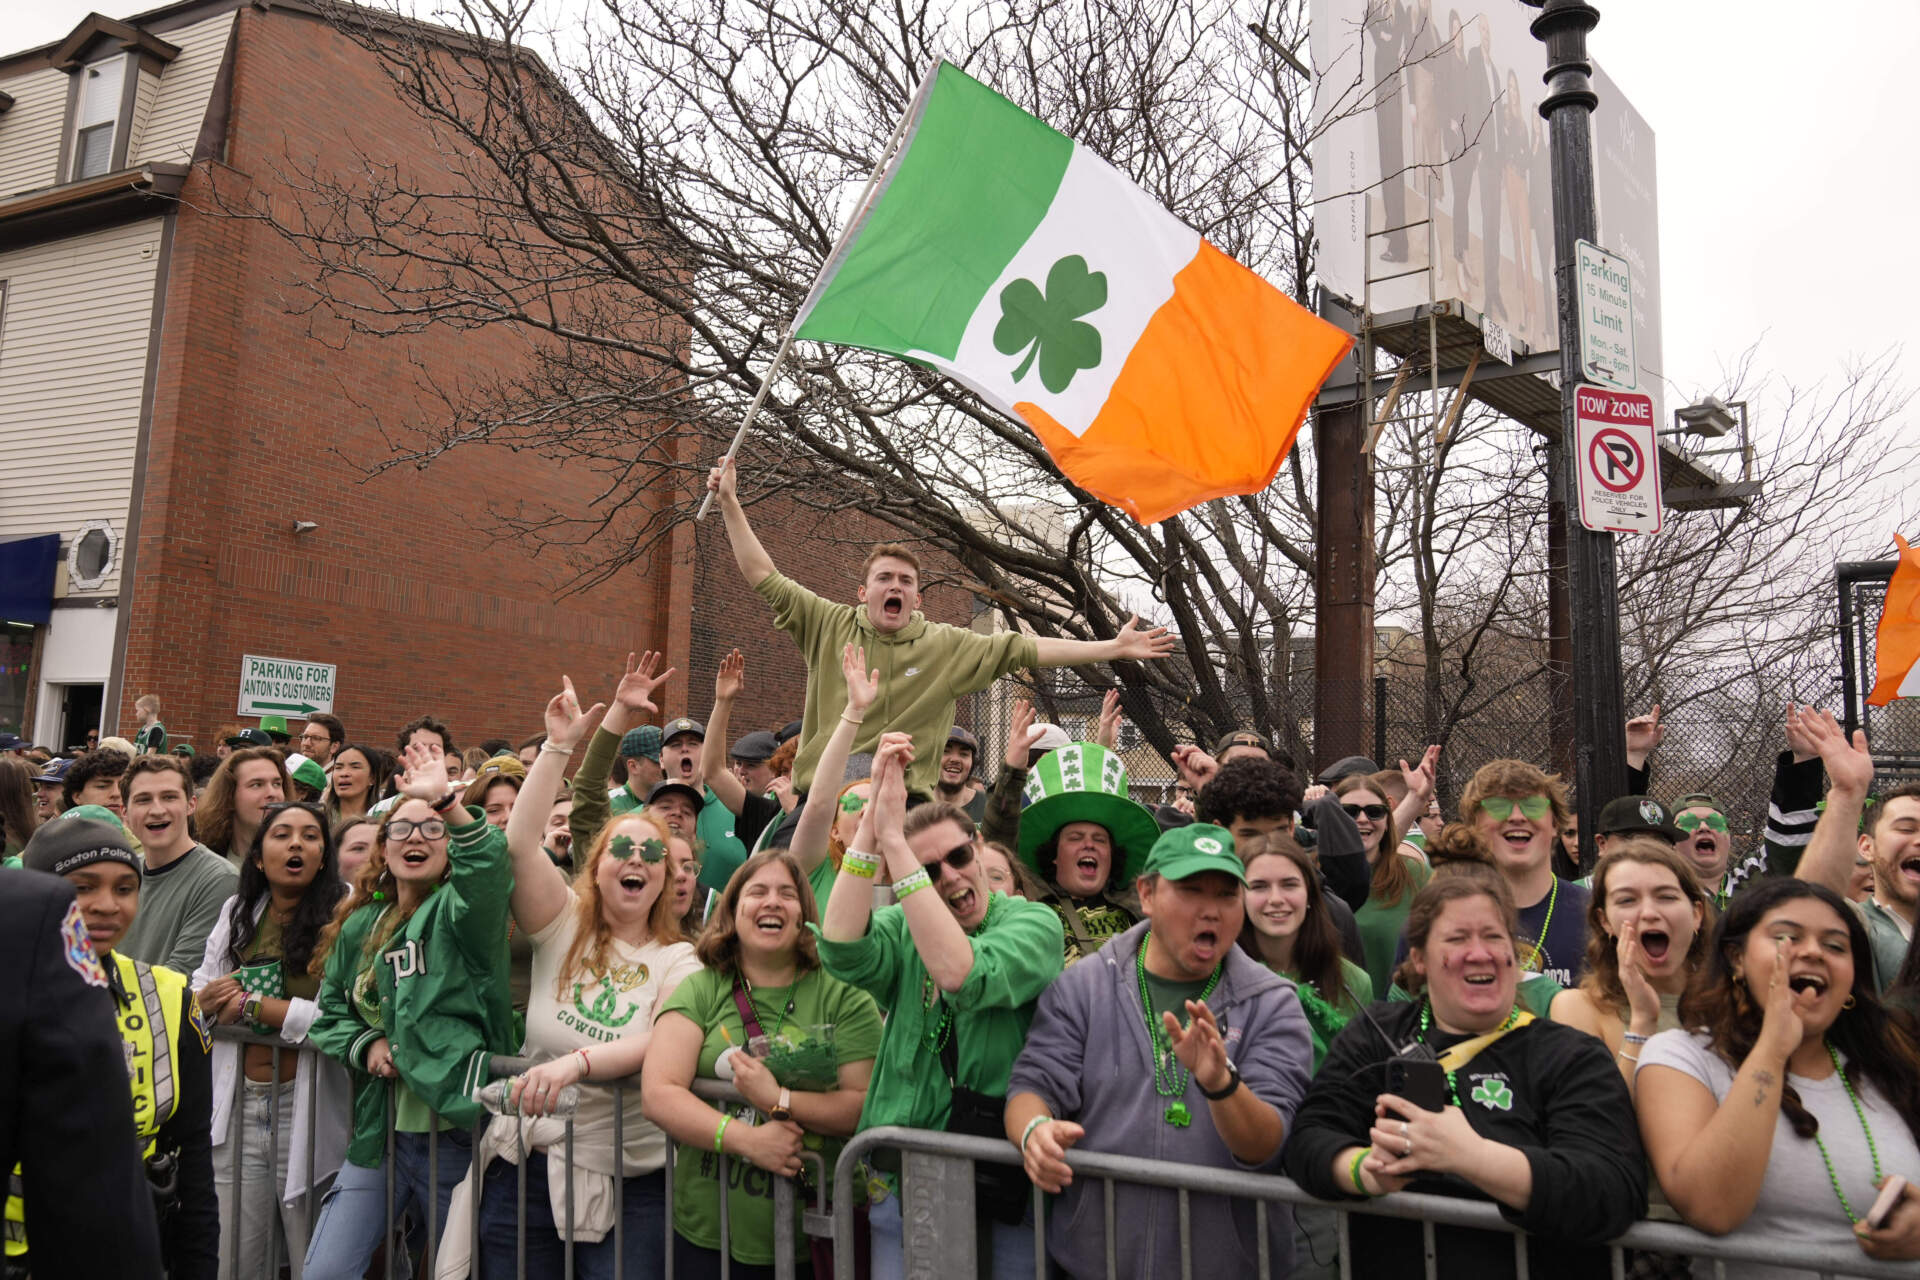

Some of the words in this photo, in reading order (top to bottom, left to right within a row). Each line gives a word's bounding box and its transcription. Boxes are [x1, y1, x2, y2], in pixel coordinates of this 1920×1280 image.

[1582, 255, 1628, 293] Parking
[1586, 282, 1597, 297] 15
[1599, 287, 1628, 309] Minute
[1593, 306, 1623, 334] Limit
[1580, 396, 1607, 414] TOW
[1611, 401, 1650, 419] ZONE
[1591, 496, 1614, 505] POLICE
[1615, 500, 1648, 509] VEHICLES
[1594, 489, 1627, 500] RESERVED
[1610, 505, 1626, 513] ONLY
[250, 661, 303, 681] PARKING
[306, 667, 329, 683] FOR
[243, 679, 280, 698] ANTON'S
[282, 682, 331, 702] CUSTOMERS
[55, 850, 97, 872] Boston
[100, 847, 132, 860] Police
